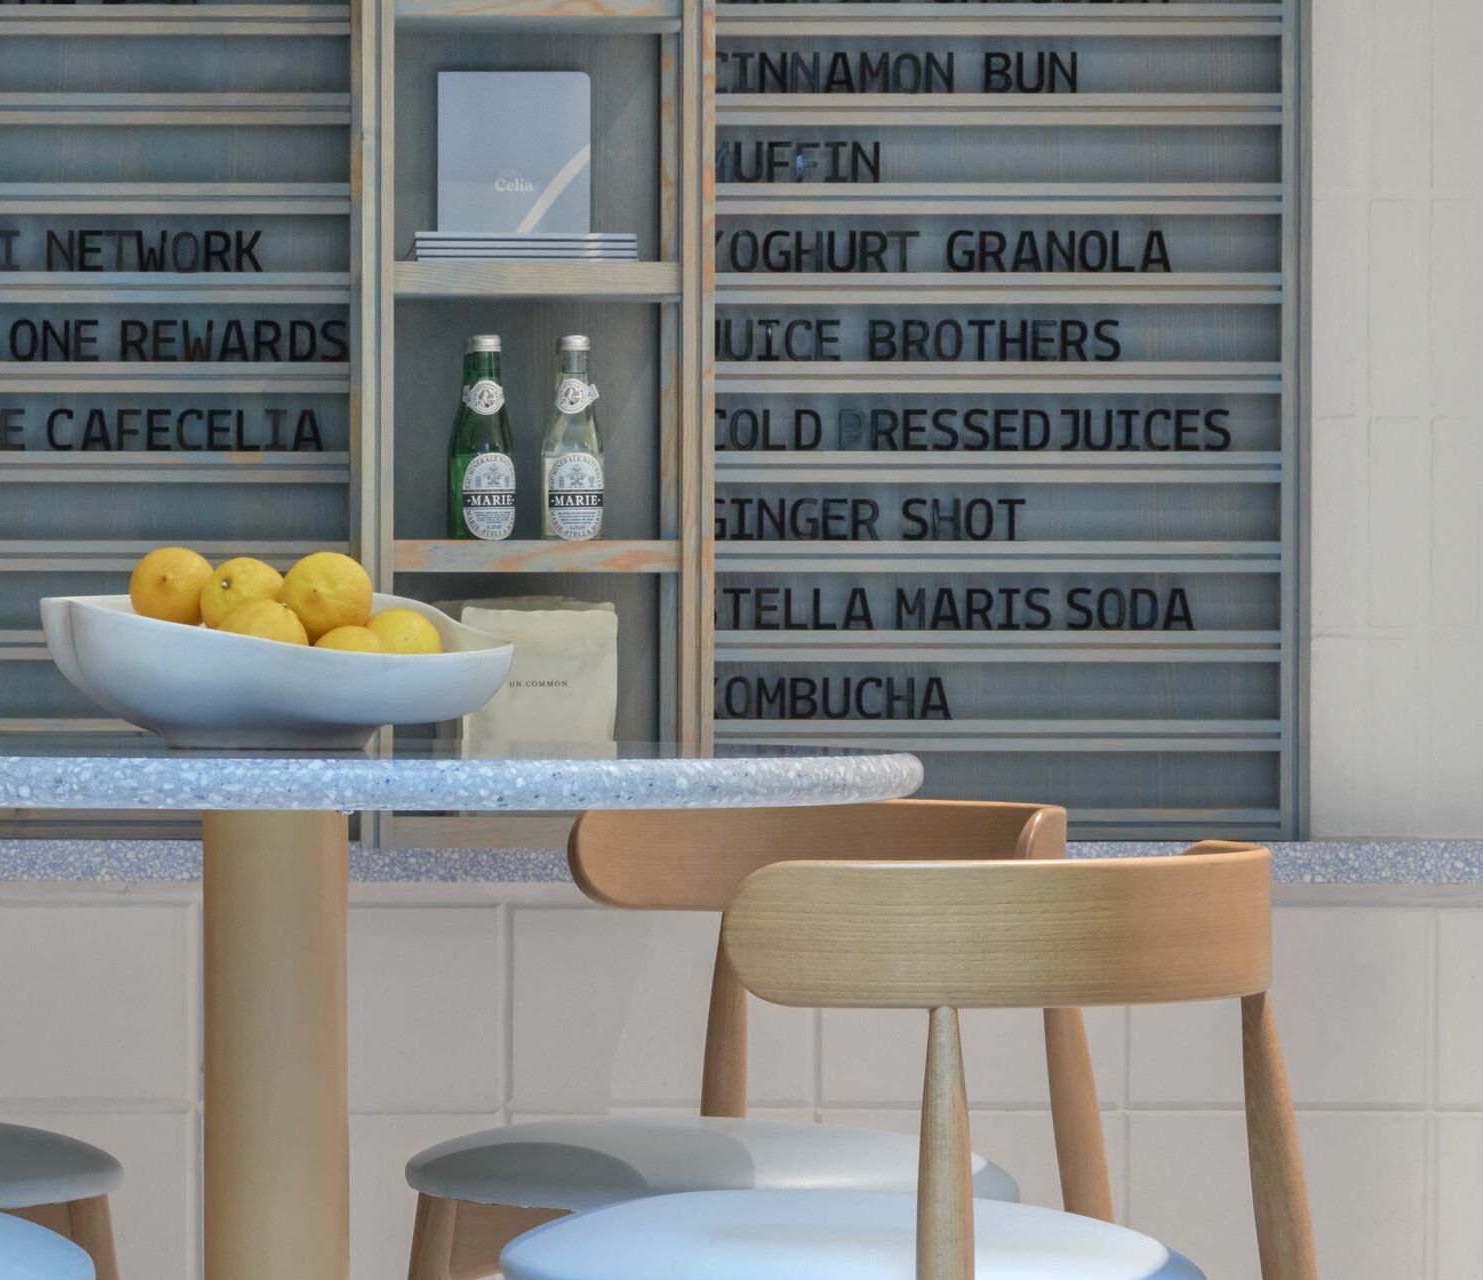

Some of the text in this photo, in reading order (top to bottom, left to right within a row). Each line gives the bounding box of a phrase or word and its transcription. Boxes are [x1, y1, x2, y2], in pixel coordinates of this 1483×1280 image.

[983, 51, 1078, 93] BUN
[494, 178, 535, 193] Celia
[46, 230, 262, 273] NETWORK
[715, 230, 1172, 272] OGHURT GRANOLA
[9, 319, 100, 362] ONE
[120, 319, 348, 362] REWARDS
[715, 319, 1122, 361] UICE BROTHERS
[46, 408, 324, 452] CAFECELIA
[901, 498, 1026, 541] SHOT
[714, 587, 1194, 630] TELLA MARIS SODA
[714, 677, 952, 719] OMBUCHA
